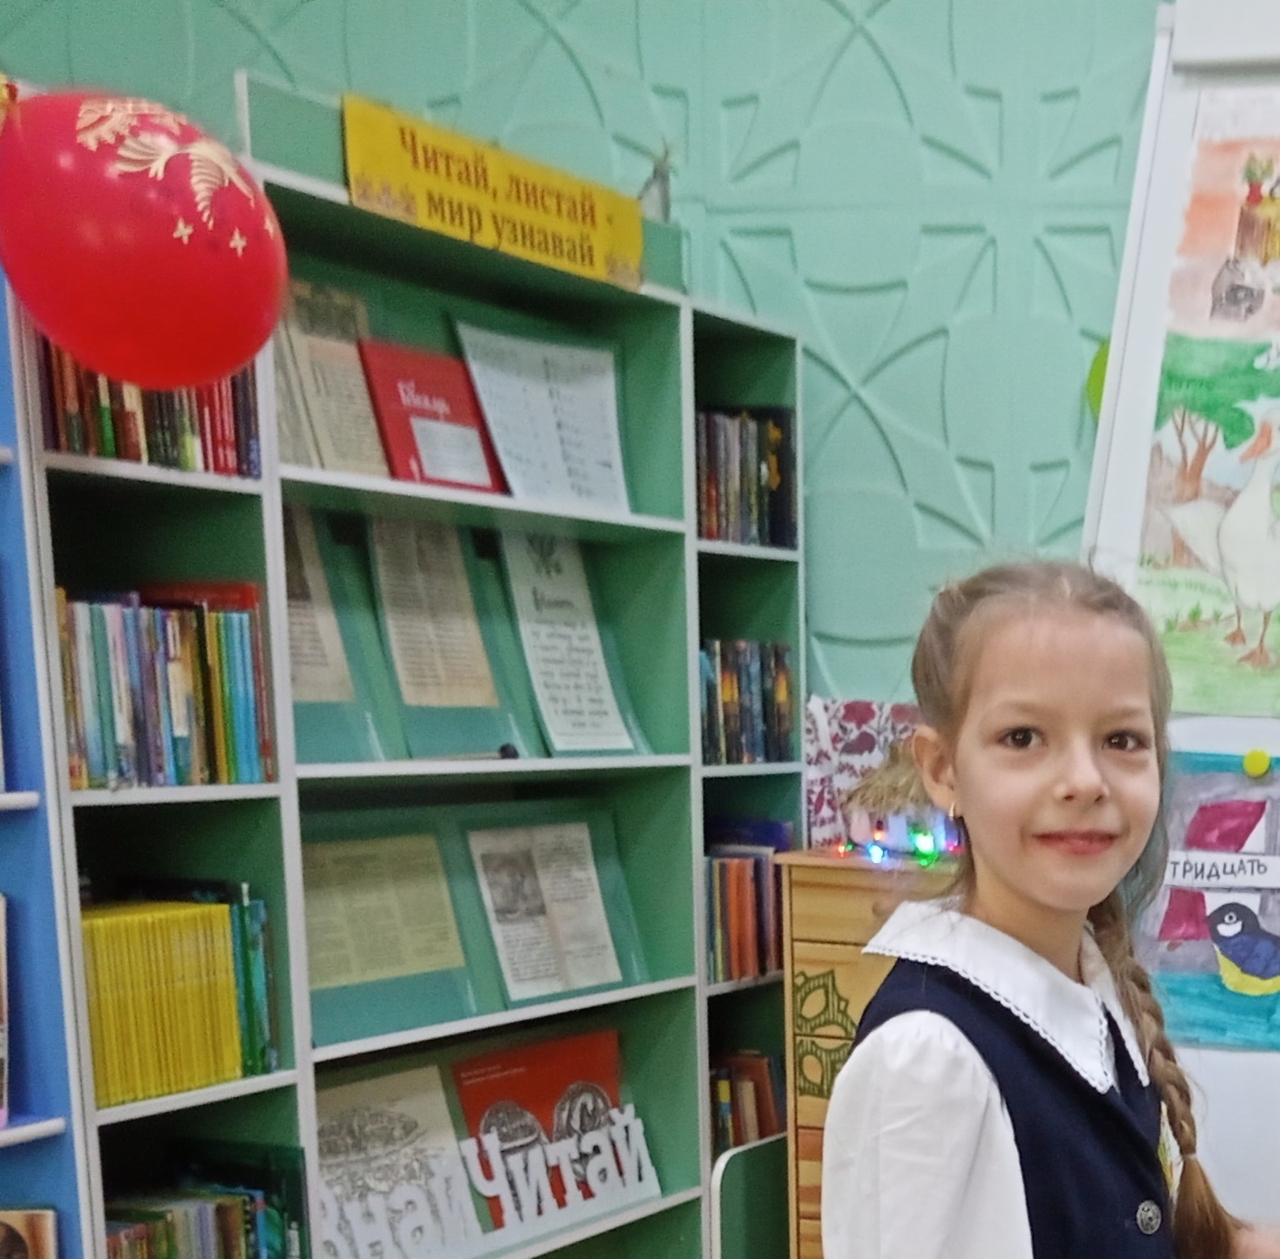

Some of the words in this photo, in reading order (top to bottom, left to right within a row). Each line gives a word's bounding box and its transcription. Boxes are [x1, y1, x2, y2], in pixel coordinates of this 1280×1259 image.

[400, 127, 498, 200] Читай,
[508, 174, 596, 226] листай
[427, 190, 483, 241] мир
[491, 211, 595, 266] узнавай
[1170, 858, 1268, 880] ТРИДЦАТЬ
